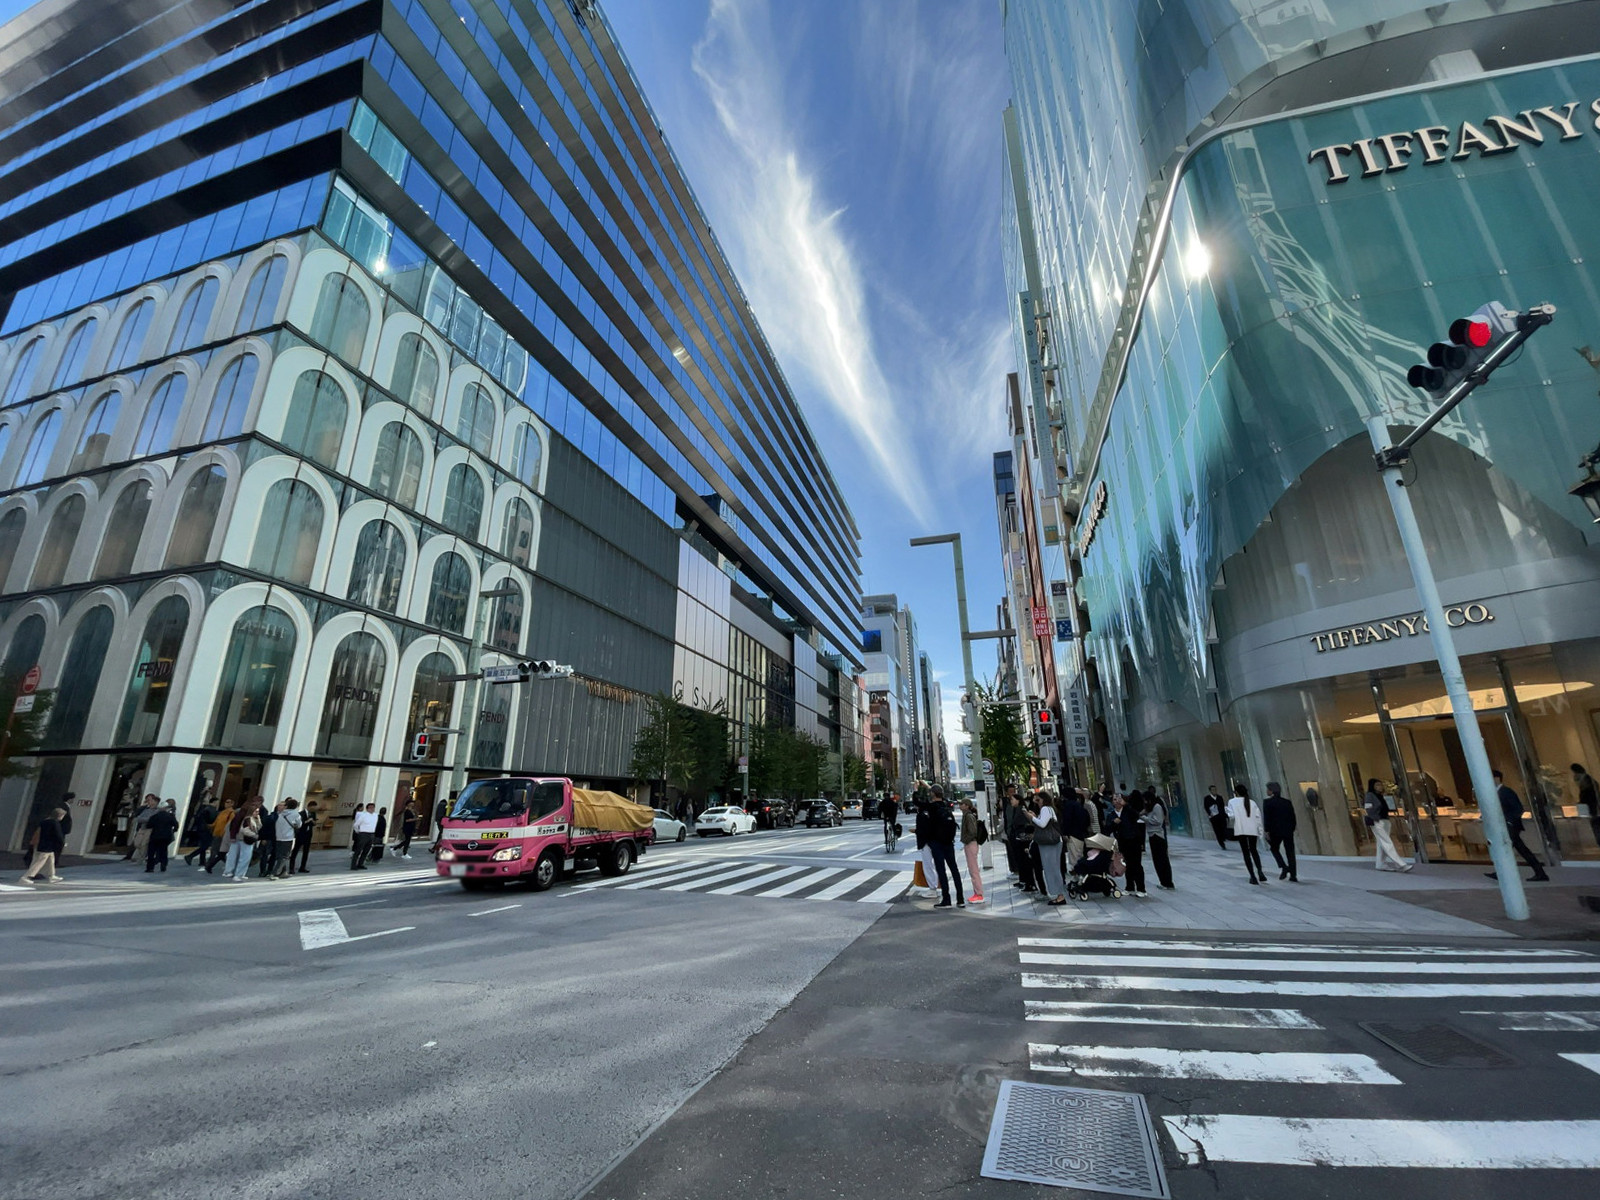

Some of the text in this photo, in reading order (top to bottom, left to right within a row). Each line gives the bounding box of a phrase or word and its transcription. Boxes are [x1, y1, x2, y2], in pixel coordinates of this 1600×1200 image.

[1308, 101, 1584, 186] TIFFANY
[1310, 615, 1420, 653] TIFFANY
[1444, 603, 1496, 629] CO.
[334, 685, 380, 702] FENDI
[480, 710, 505, 724] FENDI
